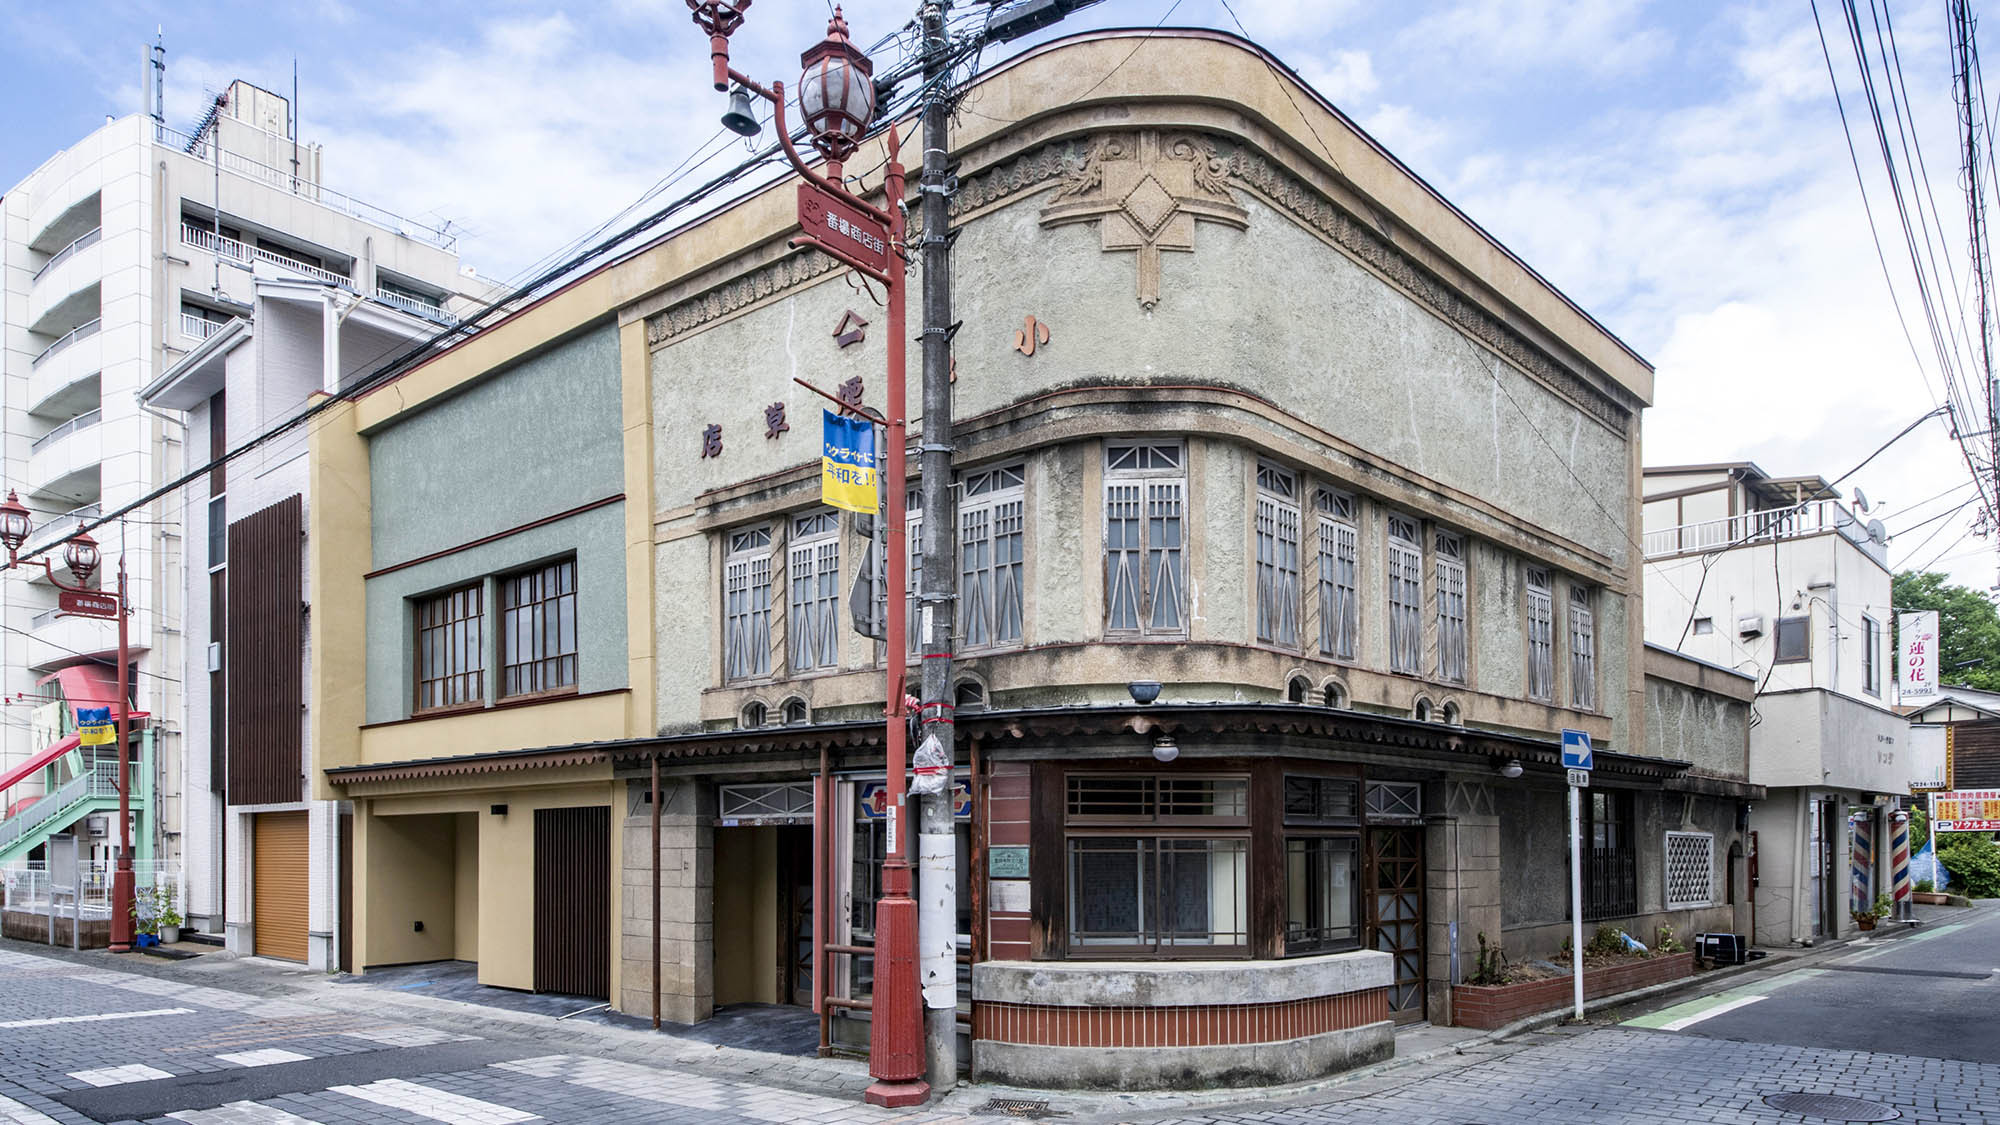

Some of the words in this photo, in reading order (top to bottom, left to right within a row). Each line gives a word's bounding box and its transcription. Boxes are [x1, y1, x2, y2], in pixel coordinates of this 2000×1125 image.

[827, 211, 884, 255] 番場商店街
[1909, 641, 1925, 682] 蓮の花
[1937, 821, 1952, 830] P
